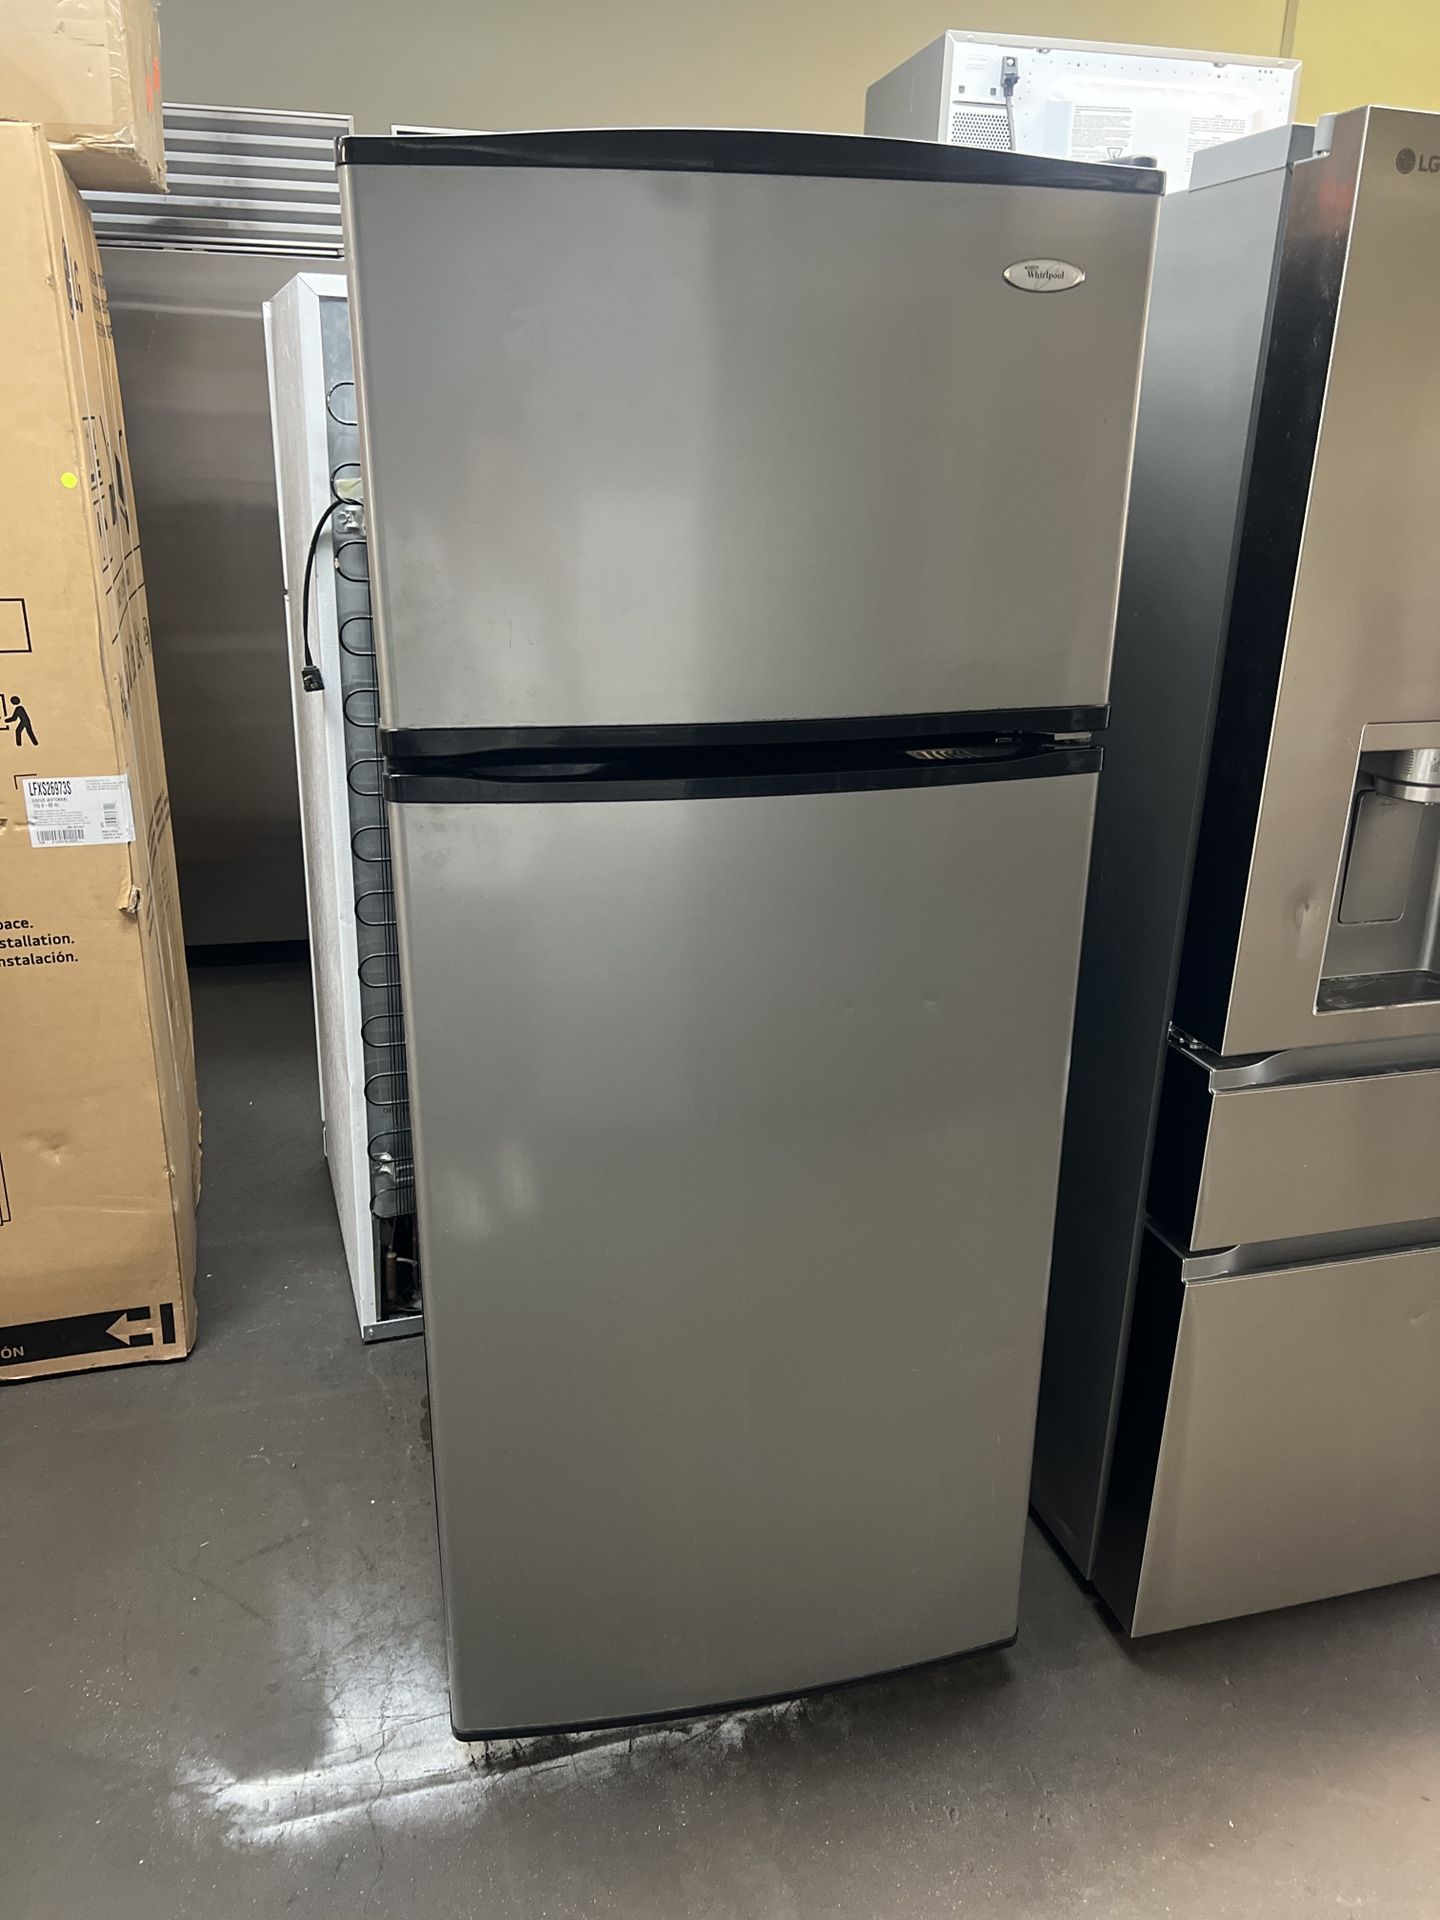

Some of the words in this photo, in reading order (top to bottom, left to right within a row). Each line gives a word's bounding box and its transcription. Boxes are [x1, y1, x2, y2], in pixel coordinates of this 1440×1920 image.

[1419, 154, 1440, 173] LG
[1027, 269, 1065, 281] Whirlpool
[28, 780, 72, 796] LFXS26973S
[0, 933, 75, 949] stallation.
